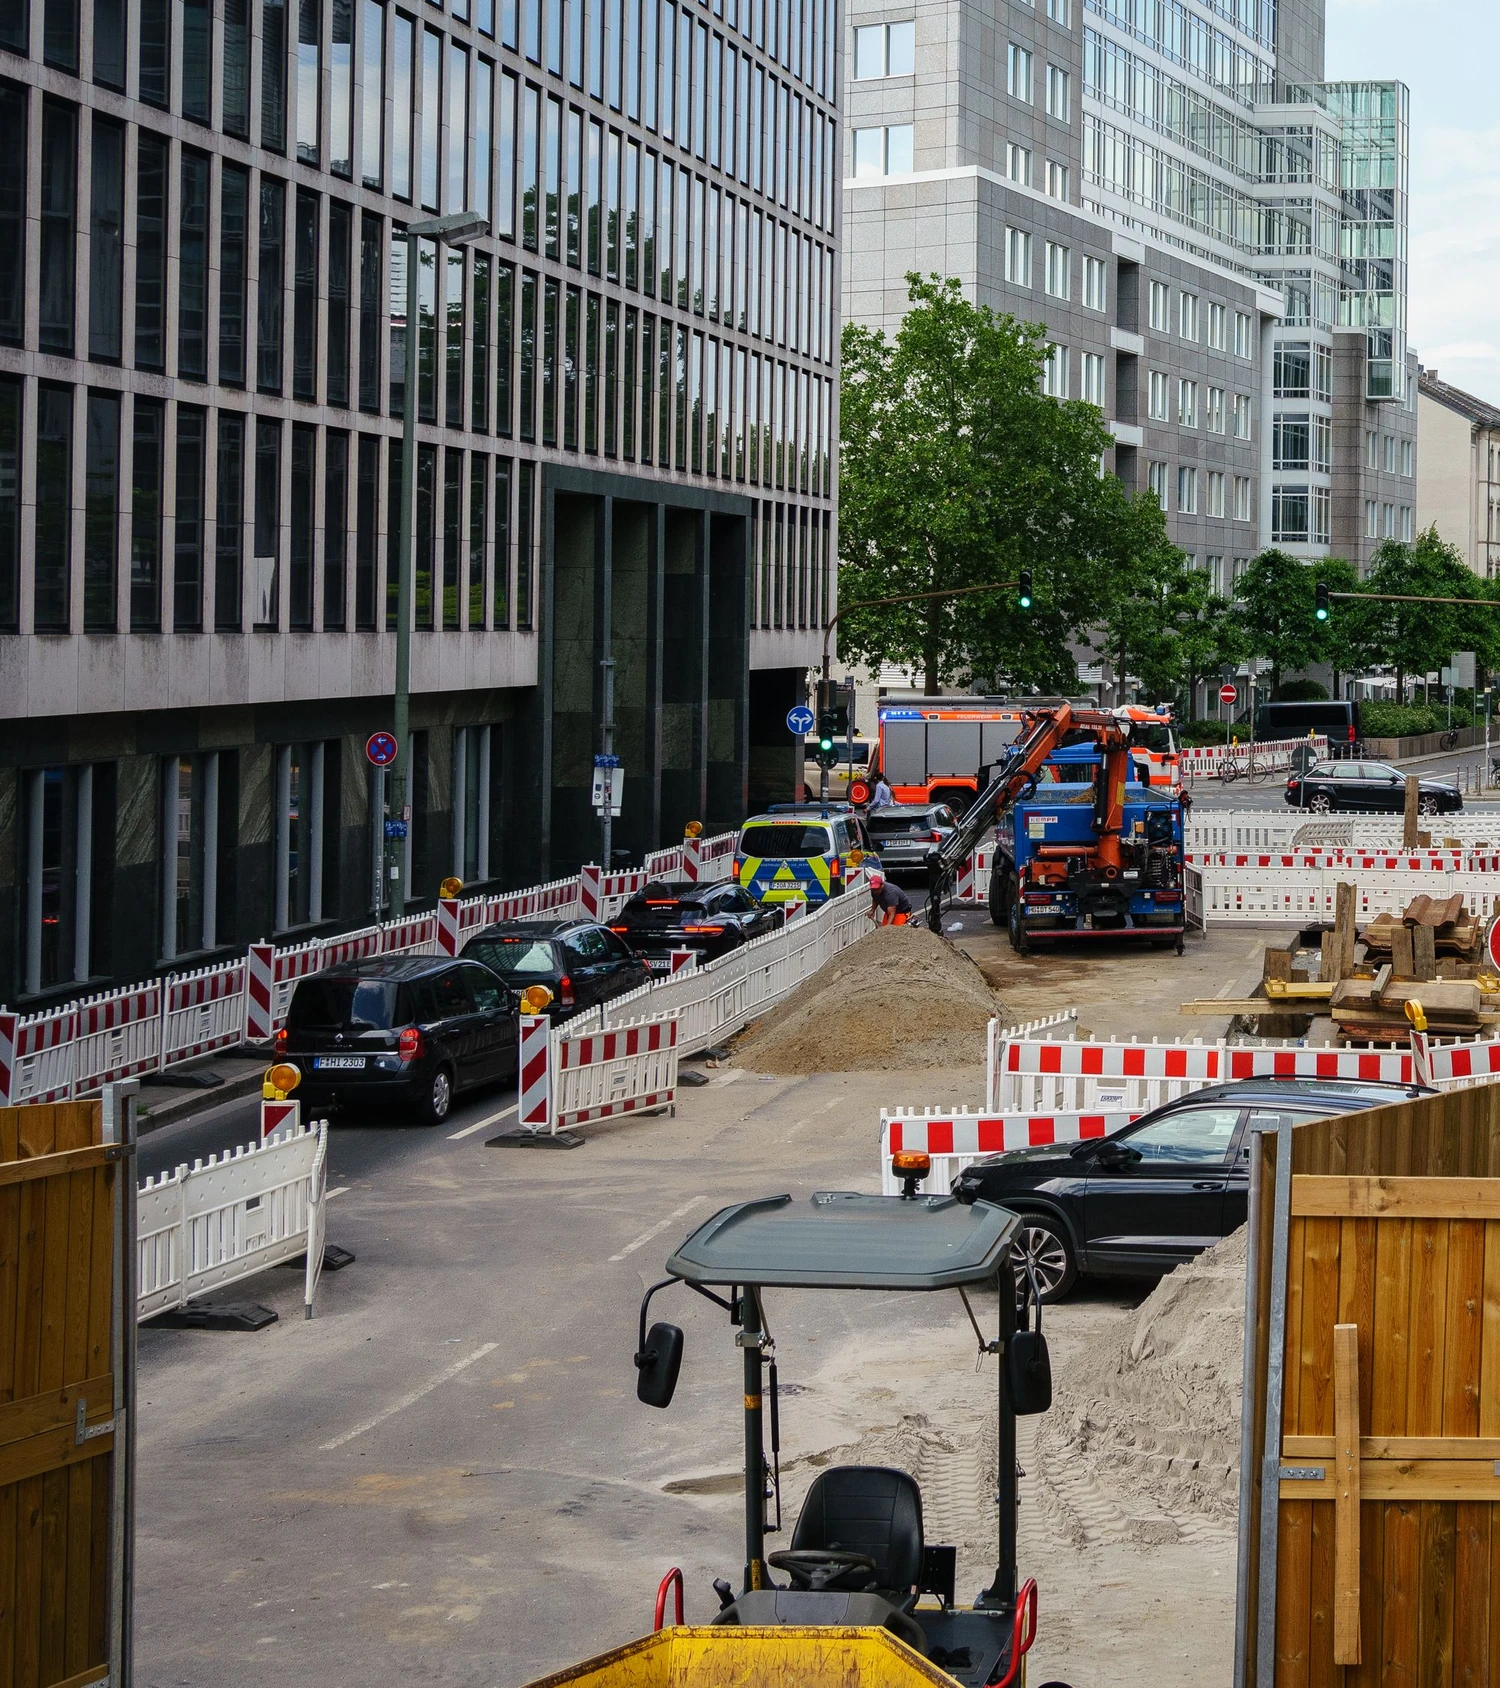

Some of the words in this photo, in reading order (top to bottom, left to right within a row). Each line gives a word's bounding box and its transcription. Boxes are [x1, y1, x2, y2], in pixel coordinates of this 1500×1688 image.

[320, 1058, 325, 1067] F
[330, 1058, 341, 1066] HI
[343, 1058, 364, 1067] 2303
